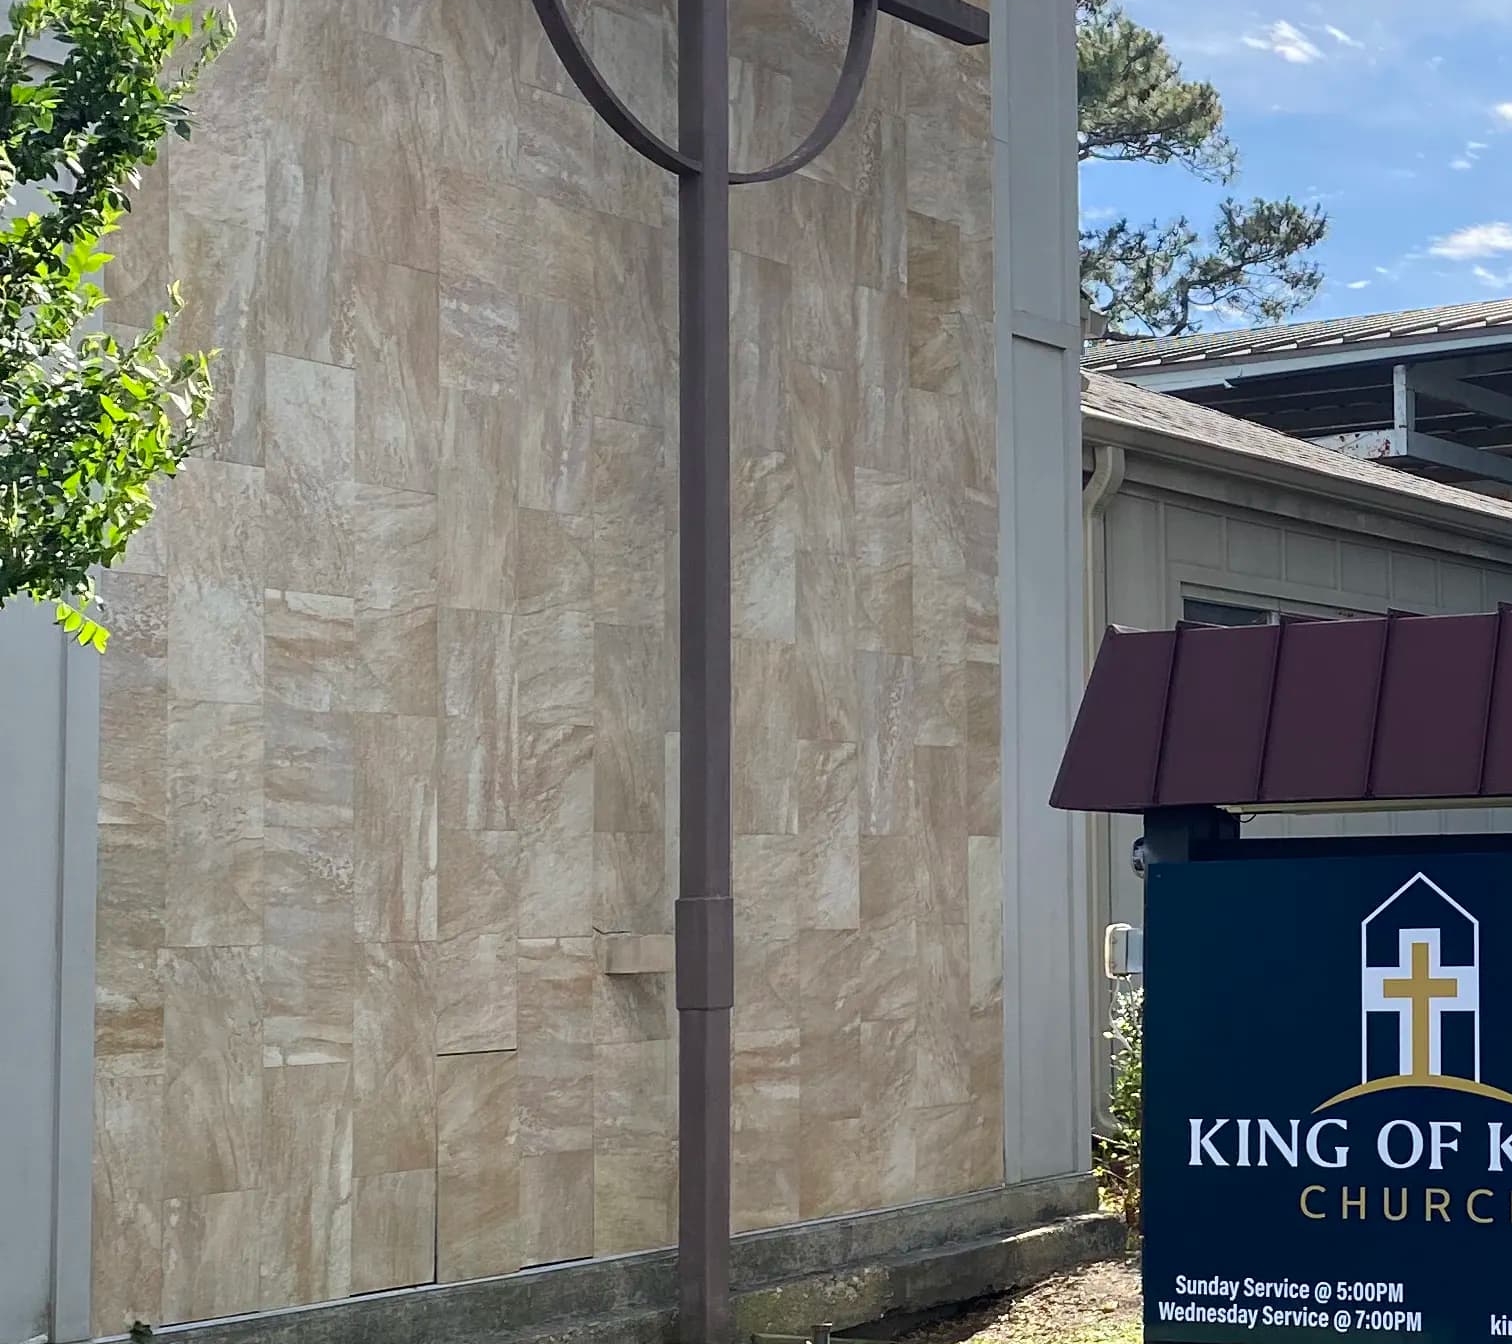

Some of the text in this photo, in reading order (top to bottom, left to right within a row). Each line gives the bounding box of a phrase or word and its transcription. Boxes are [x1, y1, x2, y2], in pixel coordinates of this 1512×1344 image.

[1188, 1118, 1350, 1168] KING
[1377, 1119, 1462, 1170] OF
[1175, 1274, 1404, 1304] Sunday Service @ 5:00PM
[1158, 1301, 1422, 1333] Wednesday Service @ 7:00PM
